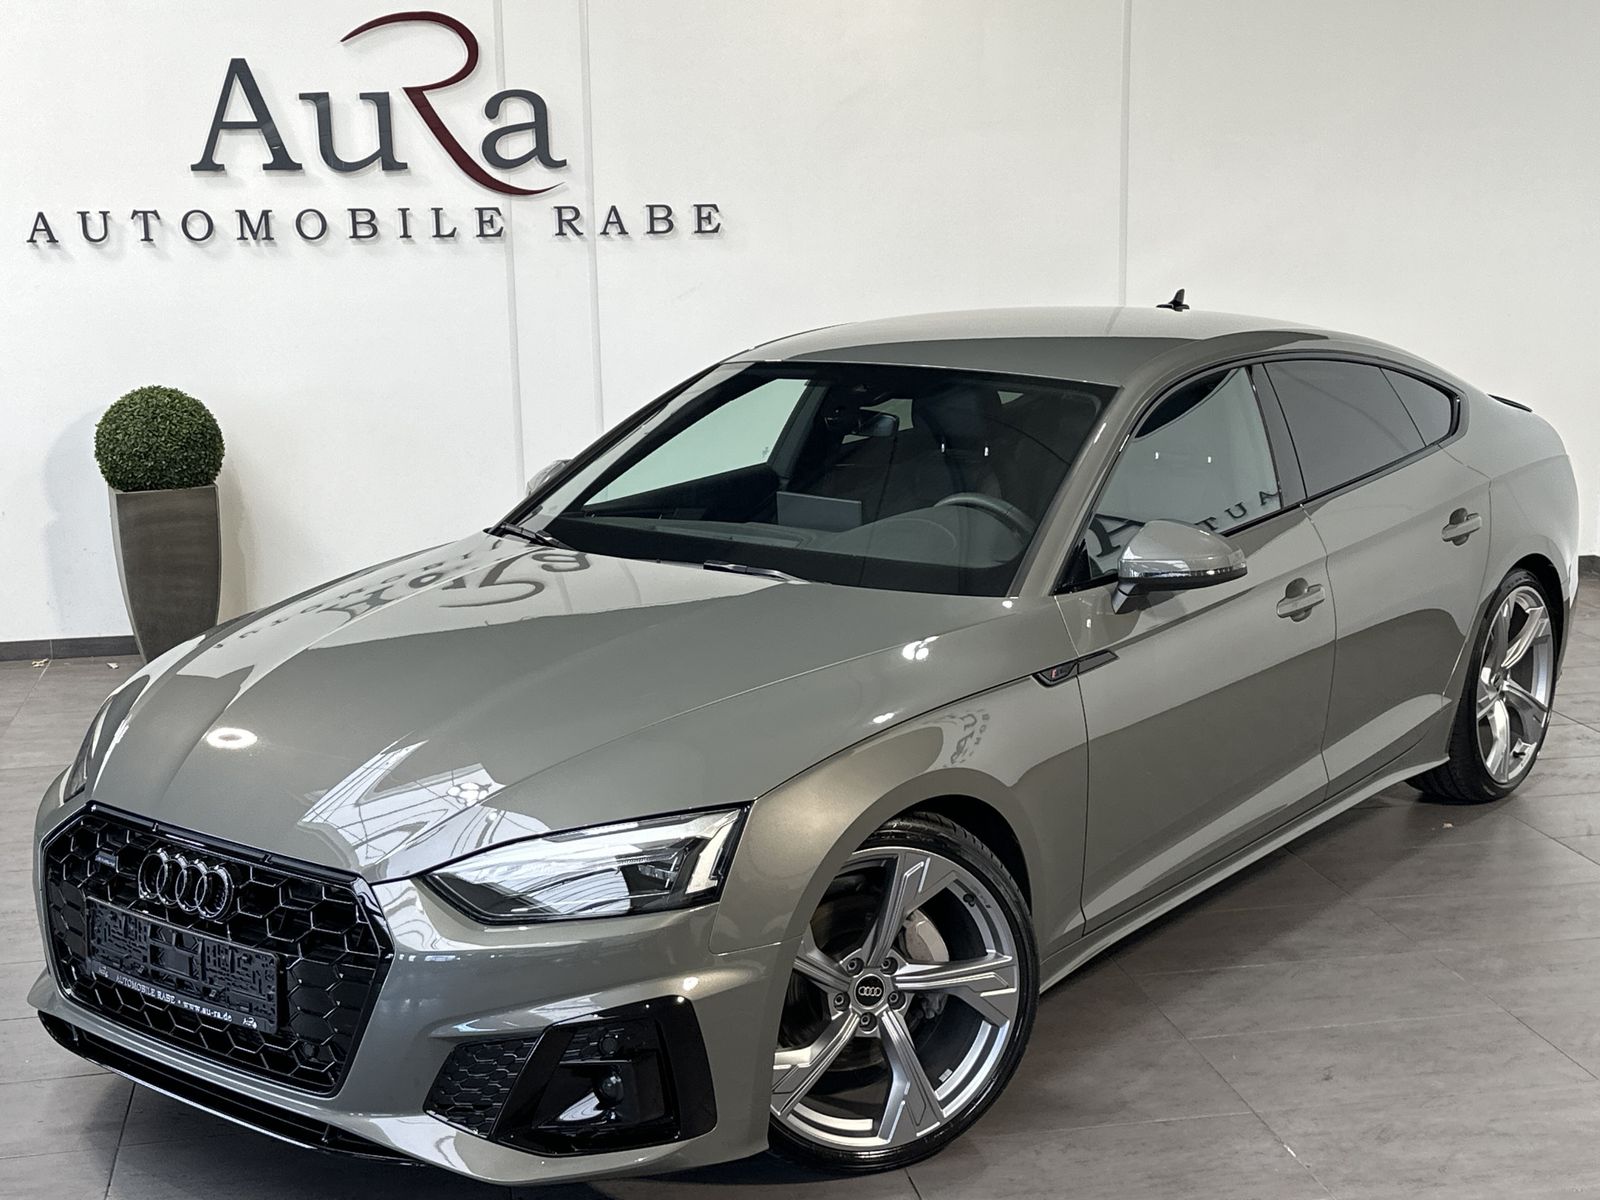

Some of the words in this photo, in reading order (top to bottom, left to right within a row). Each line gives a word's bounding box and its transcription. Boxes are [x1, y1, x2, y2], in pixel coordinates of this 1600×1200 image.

[190, 10, 568, 197] AuRa
[26, 206, 504, 244] AUTOMOBILE
[553, 203, 721, 237] RABE
